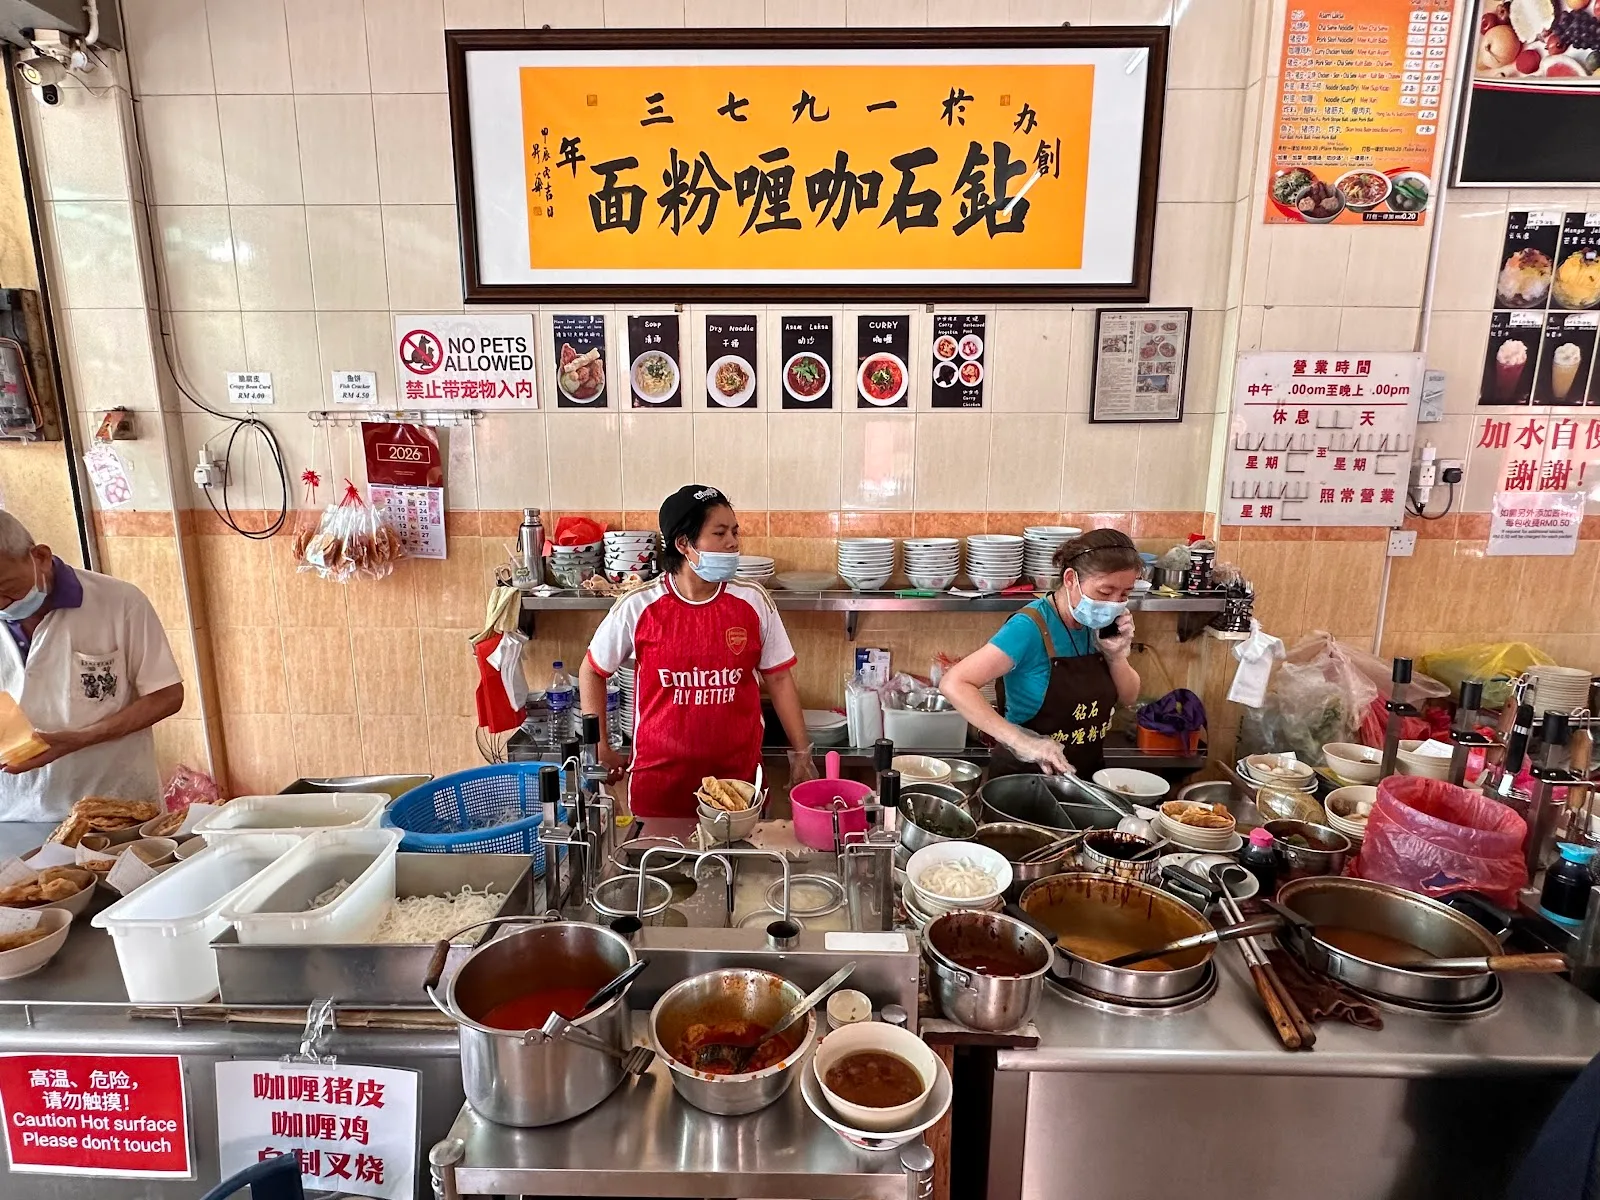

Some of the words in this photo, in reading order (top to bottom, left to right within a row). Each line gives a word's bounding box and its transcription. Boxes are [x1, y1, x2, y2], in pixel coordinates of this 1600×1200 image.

[709, 325, 723, 333] Dry
[868, 321, 899, 329] CURRY
[448, 337, 476, 354] NO
[480, 336, 527, 354] PETS
[444, 355, 533, 372] ALLOWED
[1293, 359, 1372, 375] 營業時間
[405, 378, 533, 400] 禁止带宠物入内
[1272, 409, 1310, 425] 休息
[1360, 411, 1376, 426] 天
[389, 446, 421, 460] 2026
[1316, 447, 1328, 459] 至
[1245, 455, 1279, 469] 星期
[1334, 457, 1367, 472] 星期
[1319, 488, 1396, 504] 照常營業
[1240, 505, 1274, 518] 星期
[657, 666, 744, 688] Emirates
[672, 688, 692, 705] FLY
[694, 687, 736, 706] BETTER
[253, 1072, 386, 1109] 咖喱猪皮
[12, 1112, 77, 1128] Caution
[80, 1114, 110, 1131] Hot
[113, 1116, 177, 1133] surface
[271, 1110, 370, 1146] 咖喱鸡
[22, 1132, 78, 1148] Please
[81, 1134, 120, 1152] don't
[123, 1136, 172, 1153] touch
